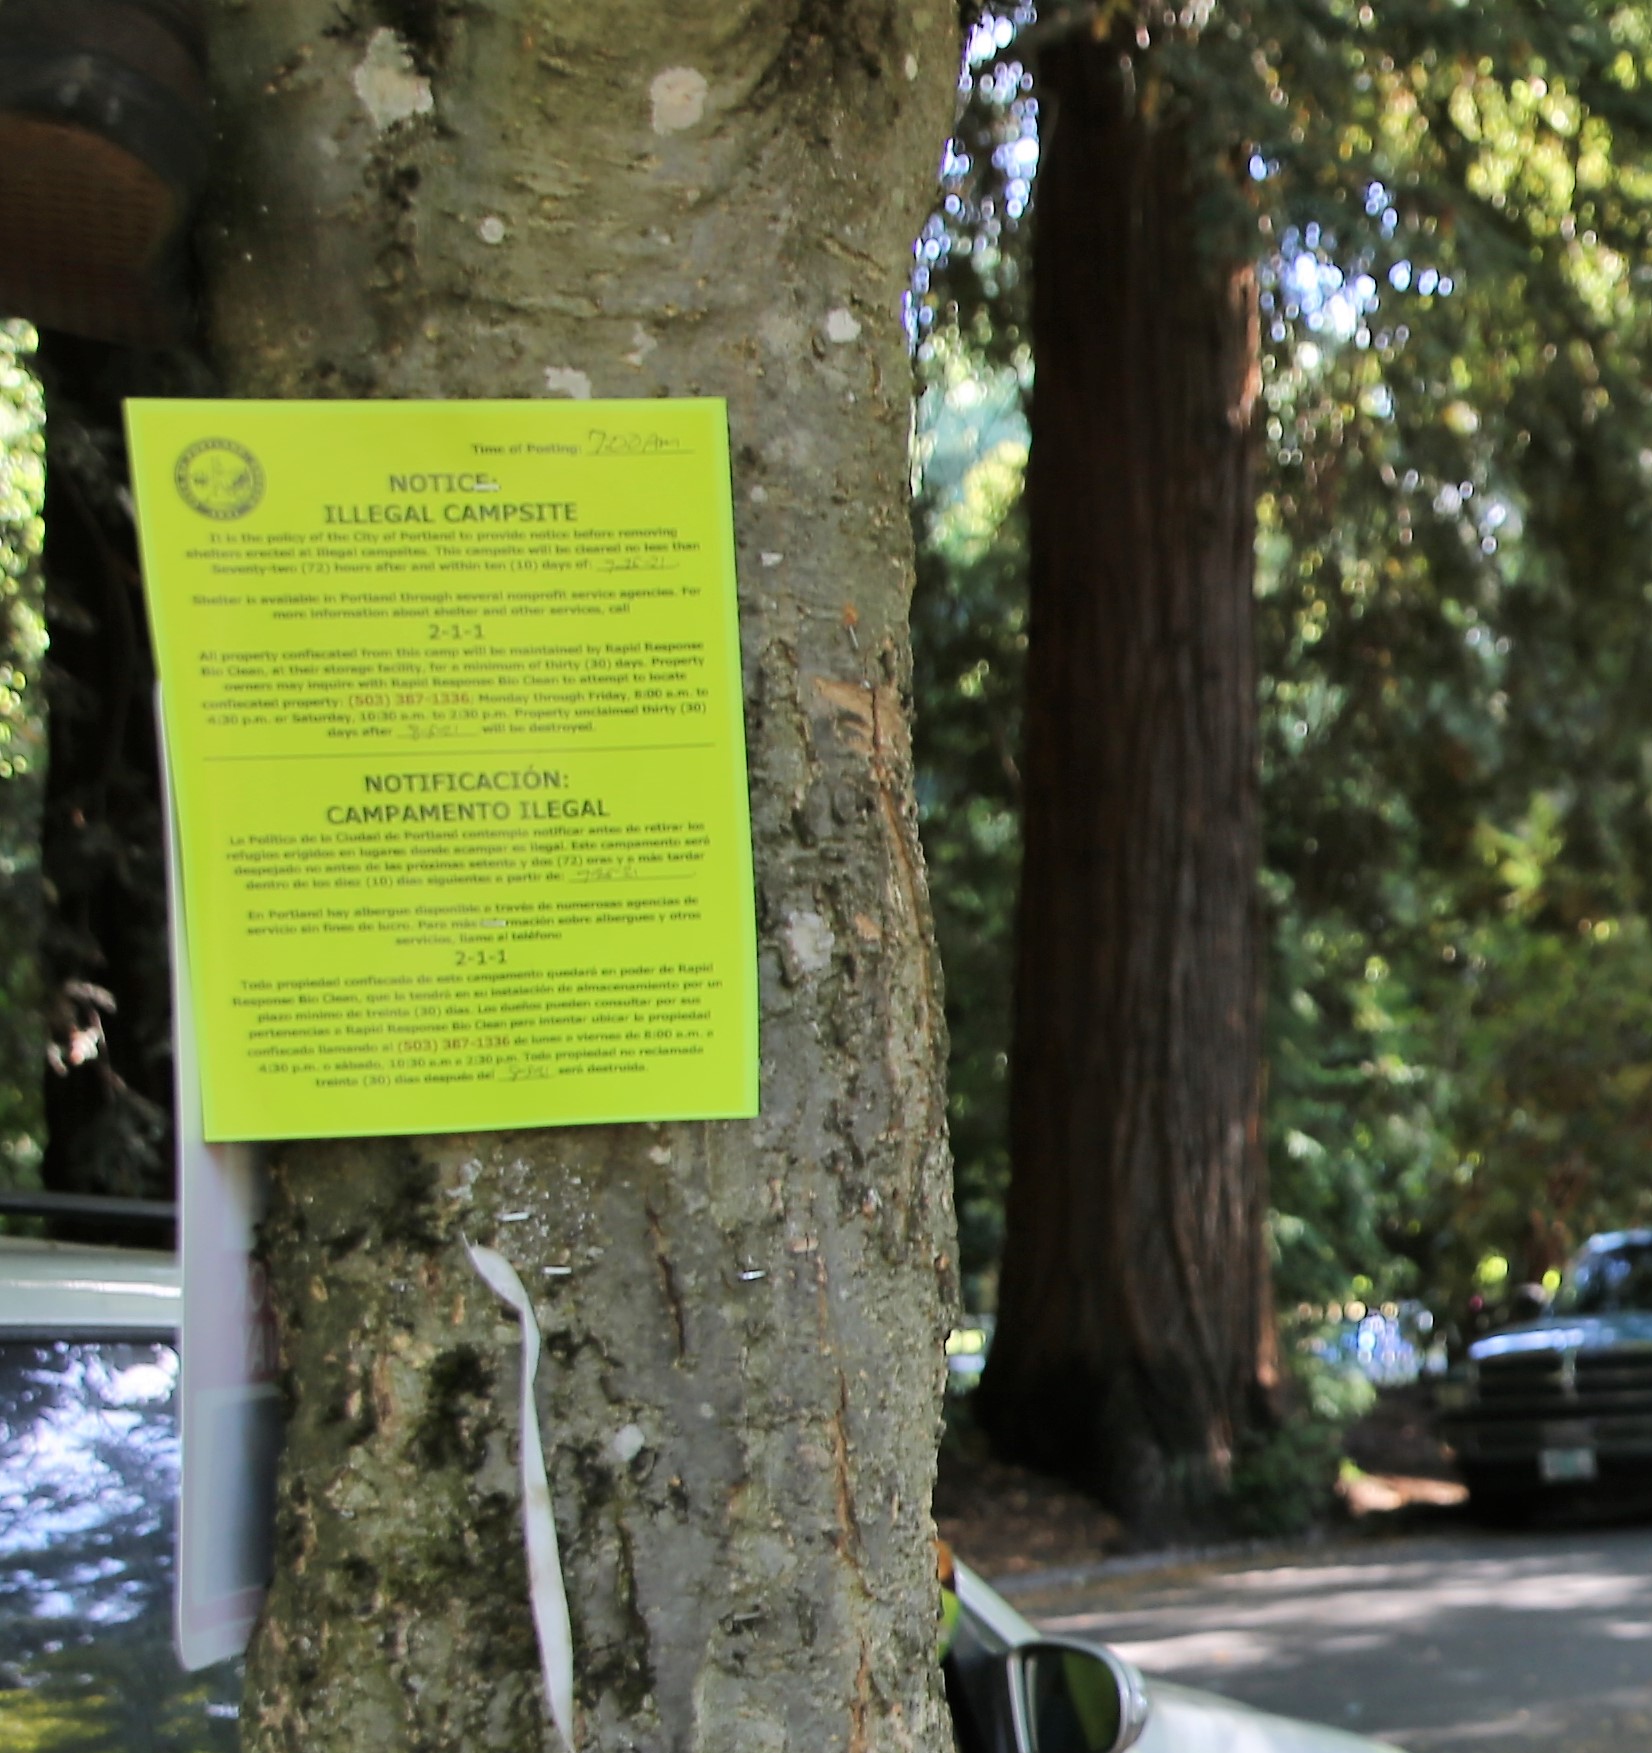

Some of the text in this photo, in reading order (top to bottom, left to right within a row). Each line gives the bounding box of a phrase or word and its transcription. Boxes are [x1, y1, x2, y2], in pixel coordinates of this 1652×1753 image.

[470, 444, 506, 454] Time
[508, 444, 523, 454] of
[324, 502, 578, 524] ILLEGAL CAMPSITE
[240, 528, 678, 544] the policy the City Portland provide notice before removing
[184, 548, 241, 559] shelters
[245, 549, 295, 558] erected
[316, 548, 357, 558] illegal
[436, 545, 461, 556] This
[465, 546, 524, 556] campsite
[528, 545, 552, 555] will
[574, 543, 621, 554] cleared
[643, 542, 669, 553] less
[671, 541, 701, 551] than
[211, 564, 297, 575] Seventy-two
[301, 562, 331, 574] (72)
[333, 562, 372, 573] hours
[375, 561, 406, 572] after
[411, 561, 436, 572] and
[439, 561, 481, 571] within
[484, 561, 506, 571] ten
[510, 560, 538, 571] (10)
[541, 560, 572, 571] days
[189, 595, 242, 605] Shelter
[259, 594, 319, 604] available
[339, 592, 397, 603] Portland
[400, 592, 452, 602] through
[456, 591, 503, 601] several
[507, 590, 567, 601] nonprofit
[571, 589, 616, 599] service
[681, 585, 701, 596] For
[272, 611, 307, 620] more
[310, 608, 389, 618] information
[392, 607, 429, 618] about
[434, 606, 478, 617] shelter
[482, 606, 507, 616] and
[510, 605, 544, 616] other
[608, 603, 631, 613] call
[428, 624, 483, 640] 2-1-1
[198, 641, 704, 662] All property confiscated from this camp will maintained Rapid Response
[198, 666, 220, 677] Bio
[288, 665, 318, 675] their
[323, 664, 372, 675] storage
[429, 661, 446, 672] for
[463, 662, 525, 671] minimum
[544, 660, 580, 670] thirty
[584, 659, 612, 669] (30)
[651, 656, 705, 666] Property
[223, 671, 687, 691] owners may inquire with Rapid Response Bio Clean attempt locate
[201, 698, 279, 709] confiscated
[348, 695, 391, 706] (503)
[478, 693, 528, 703] Monday
[533, 692, 585, 702] through
[326, 728, 358, 738] days
[362, 726, 392, 736] after
[481, 723, 506, 734] will
[325, 799, 610, 824] CAMPAMENTO ILEGAL
[455, 949, 506, 966] 2-1-1
